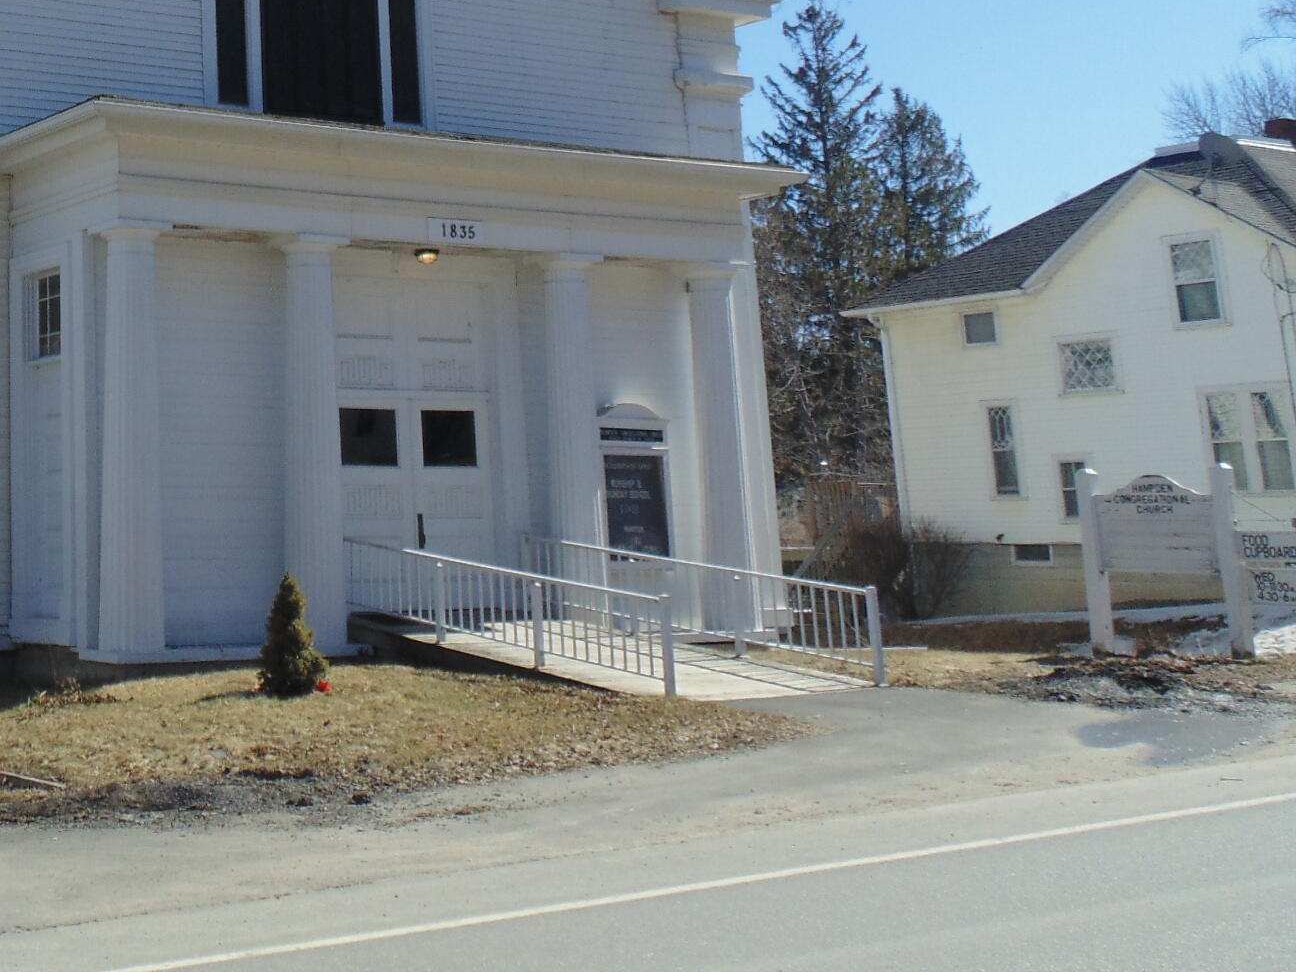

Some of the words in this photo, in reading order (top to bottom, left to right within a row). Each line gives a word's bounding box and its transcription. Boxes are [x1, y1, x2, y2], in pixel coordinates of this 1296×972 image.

[441, 222, 476, 240] 1835
[1131, 483, 1174, 493] HAMPDEN
[1113, 494, 1191, 505] CONGREGATIONAL
[1136, 504, 1174, 514] CHURCH
[1241, 534, 1269, 547] FOOD
